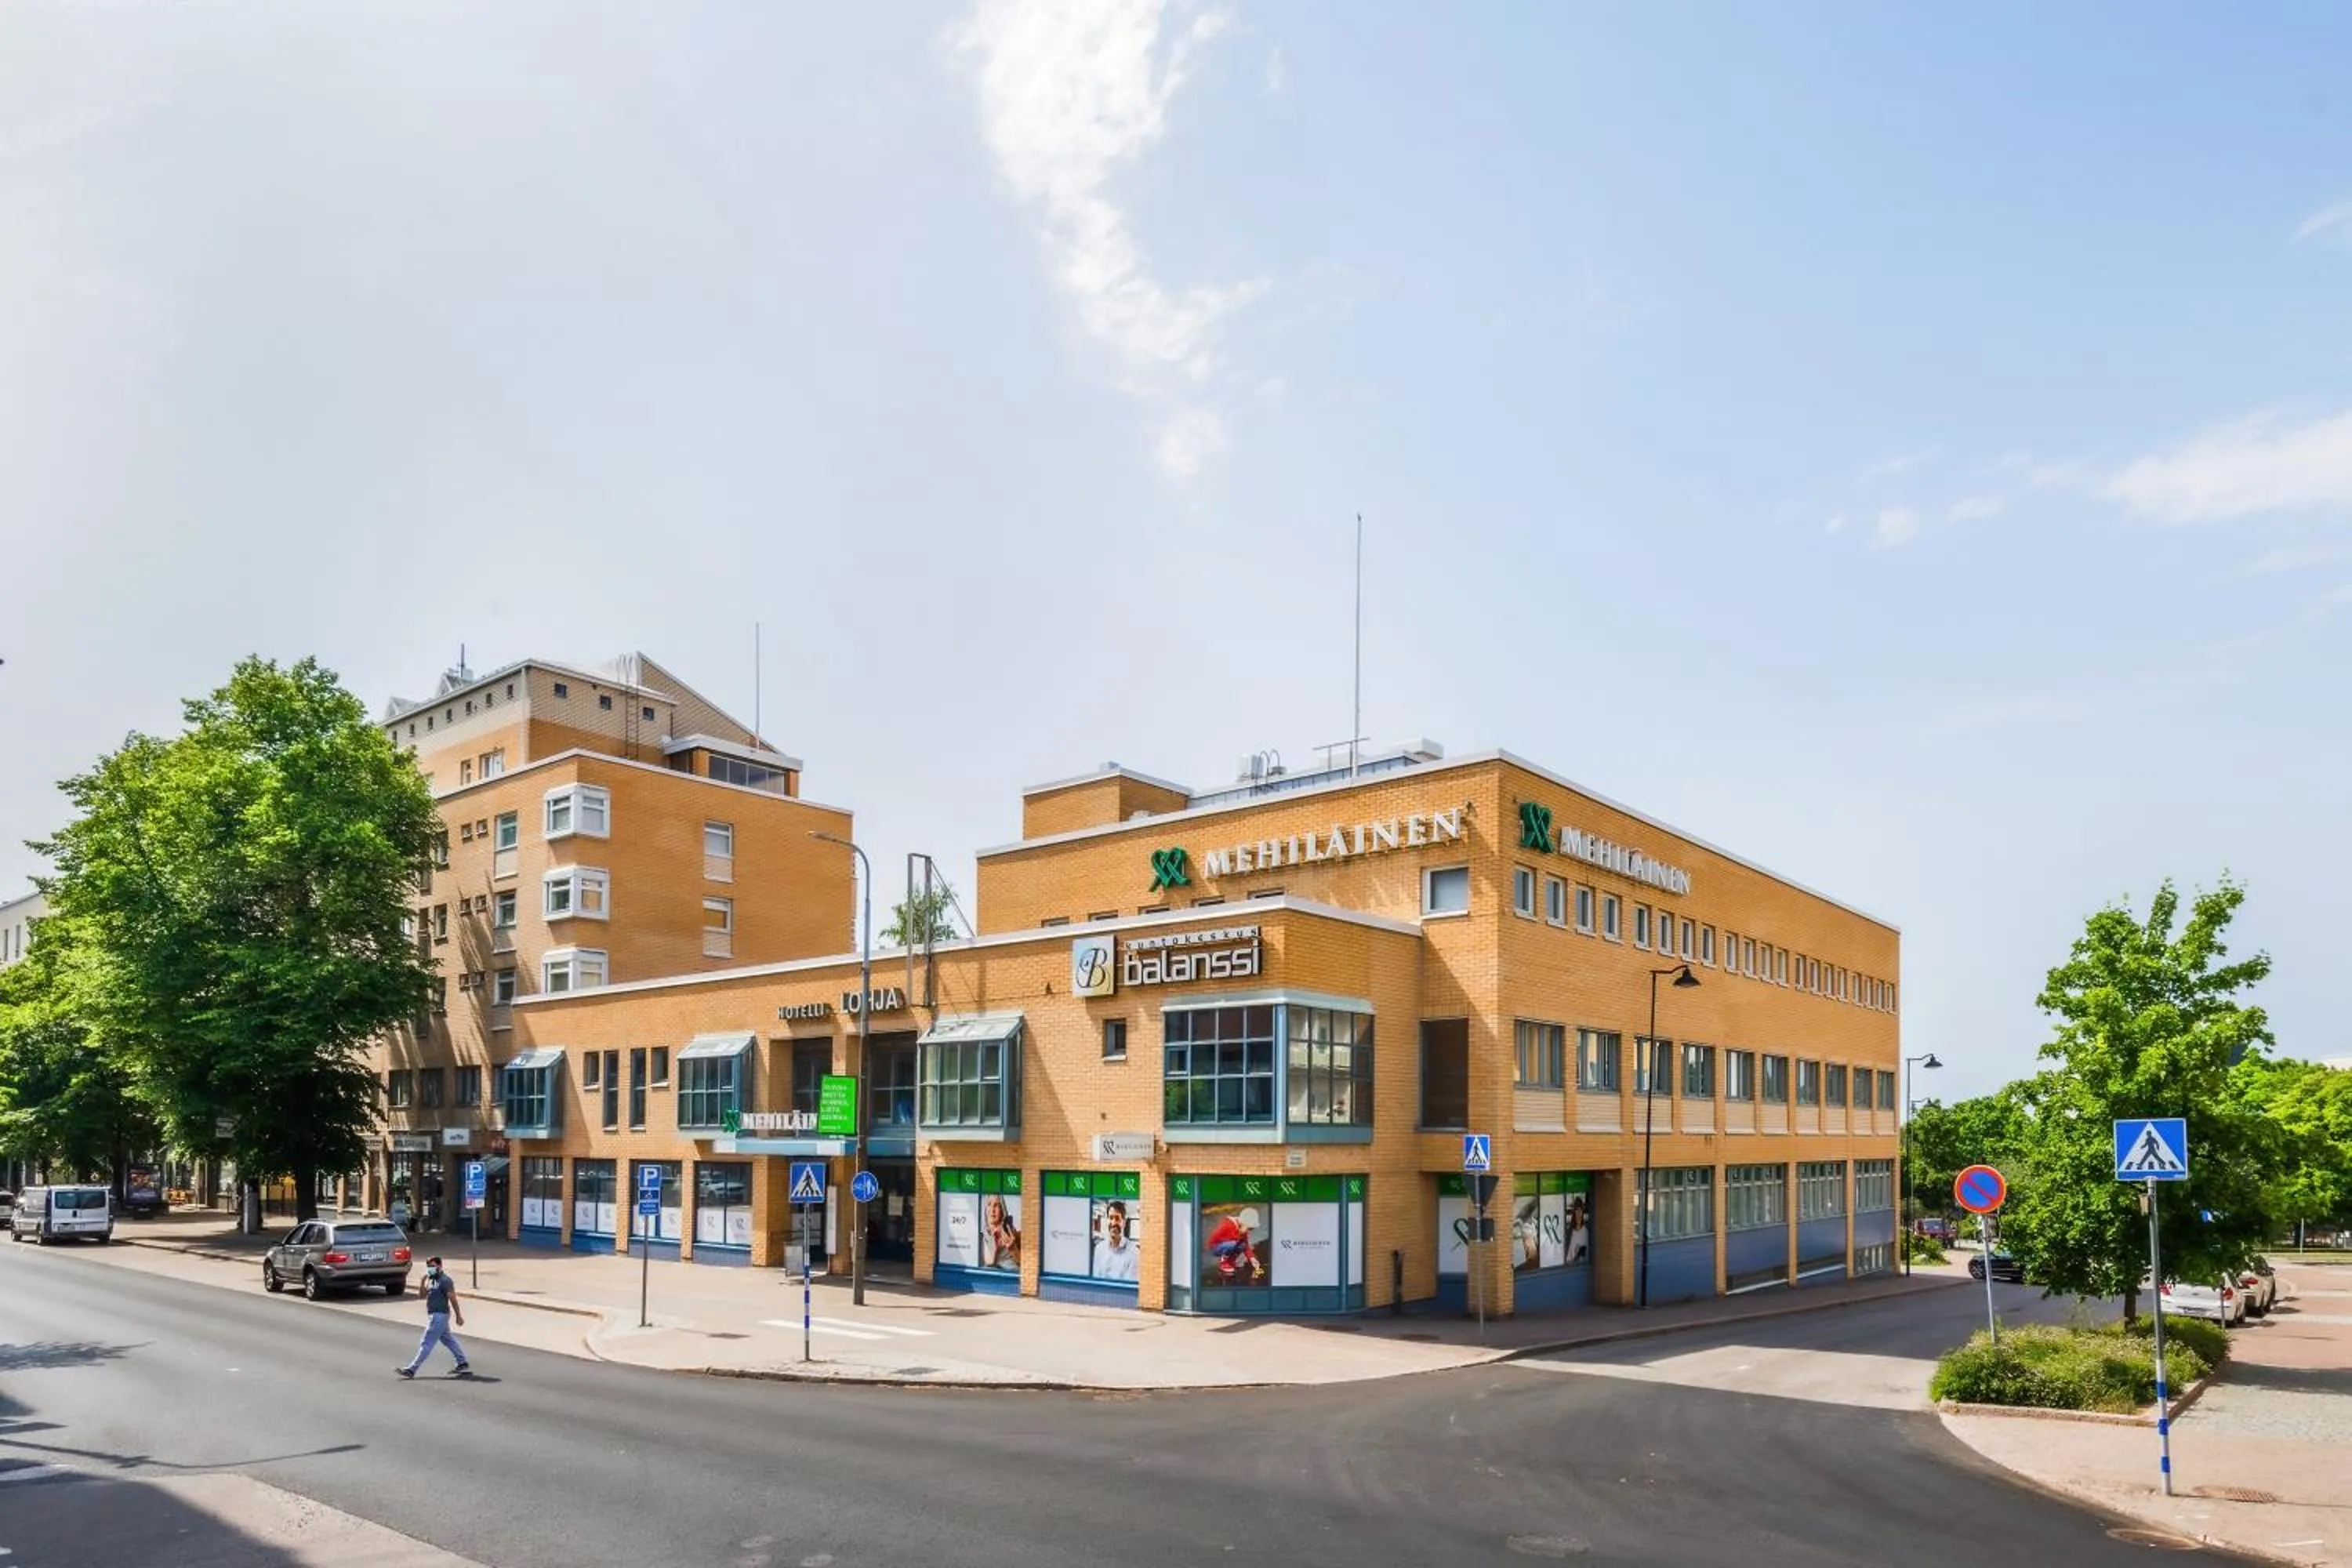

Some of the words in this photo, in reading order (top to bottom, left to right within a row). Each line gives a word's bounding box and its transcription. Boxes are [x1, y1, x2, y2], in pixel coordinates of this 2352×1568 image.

[1124, 938, 1259, 985] balanssi
[778, 1004, 824, 1019] HOTELLI
[644, 1167, 658, 1186] P
